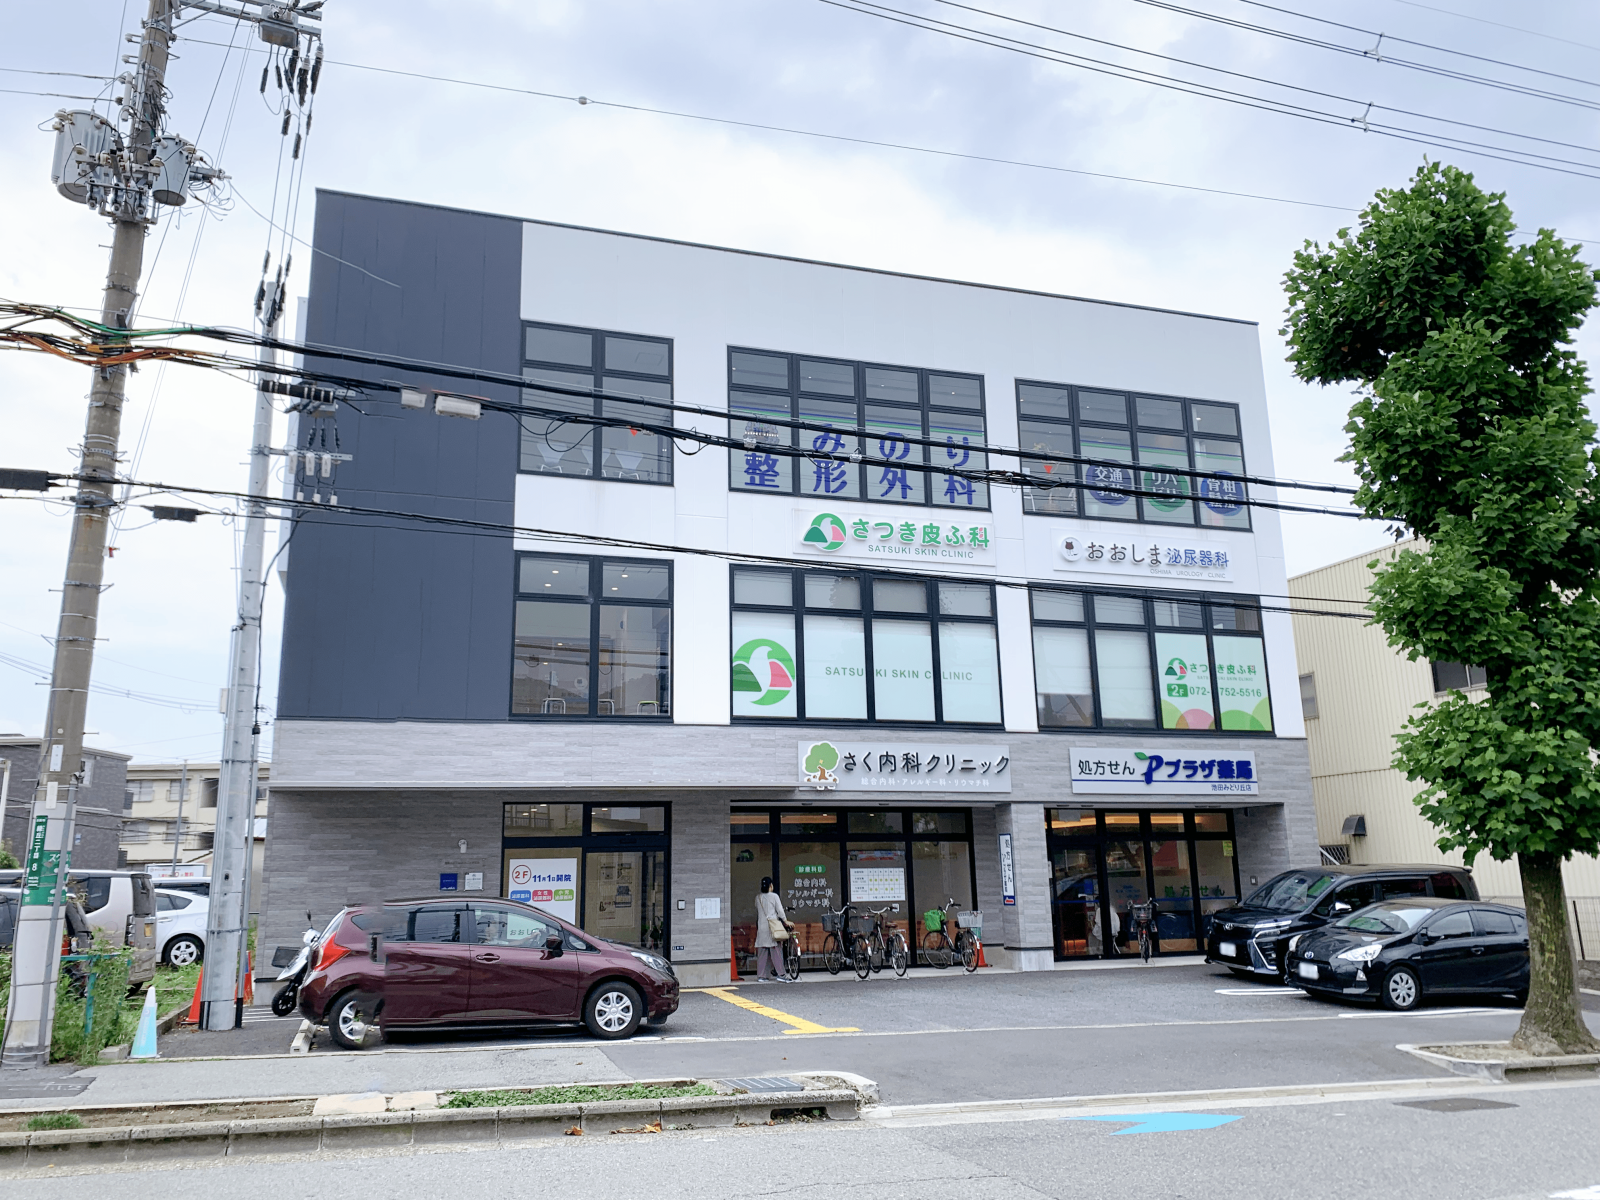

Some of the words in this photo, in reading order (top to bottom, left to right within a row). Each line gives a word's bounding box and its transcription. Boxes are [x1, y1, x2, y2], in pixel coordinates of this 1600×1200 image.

[812, 423, 970, 467] みのり
[743, 453, 976, 505] 整形外科
[1094, 466, 1124, 483] 交通
[852, 518, 990, 548] さつき皮ふ科
[868, 544, 911, 555] SATSUKI
[914, 547, 938, 556] SKIN
[941, 549, 974, 559] CLINIC
[1087, 541, 1230, 568] おおしま泌尿器科
[1150, 568, 1172, 576] OSHIMA
[891, 669, 919, 679] SKIN
[924, 670, 973, 681] CLINIC
[1189, 662, 1257, 676] さつき皮ふ科
[1171, 684, 1185, 697] 2F
[1189, 686, 1262, 697] 072-752-5516
[843, 751, 1010, 774] さく内科クリニック
[1078, 759, 1135, 776] 処方せん
[1164, 758, 1253, 780] プラザ薬局
[861, 777, 990, 787] 総合内科・アレルギー科・リウマチ科
[1211, 784, 1252, 792] 池田みどり丘店
[31, 862, 38, 872] 8
[515, 871, 529, 879] 2F
[532, 874, 572, 882] 11月1日開院
[794, 877, 827, 888] 総合内科
[787, 888, 834, 899] アレルギー科
[1164, 885, 1225, 898] 処方せん
